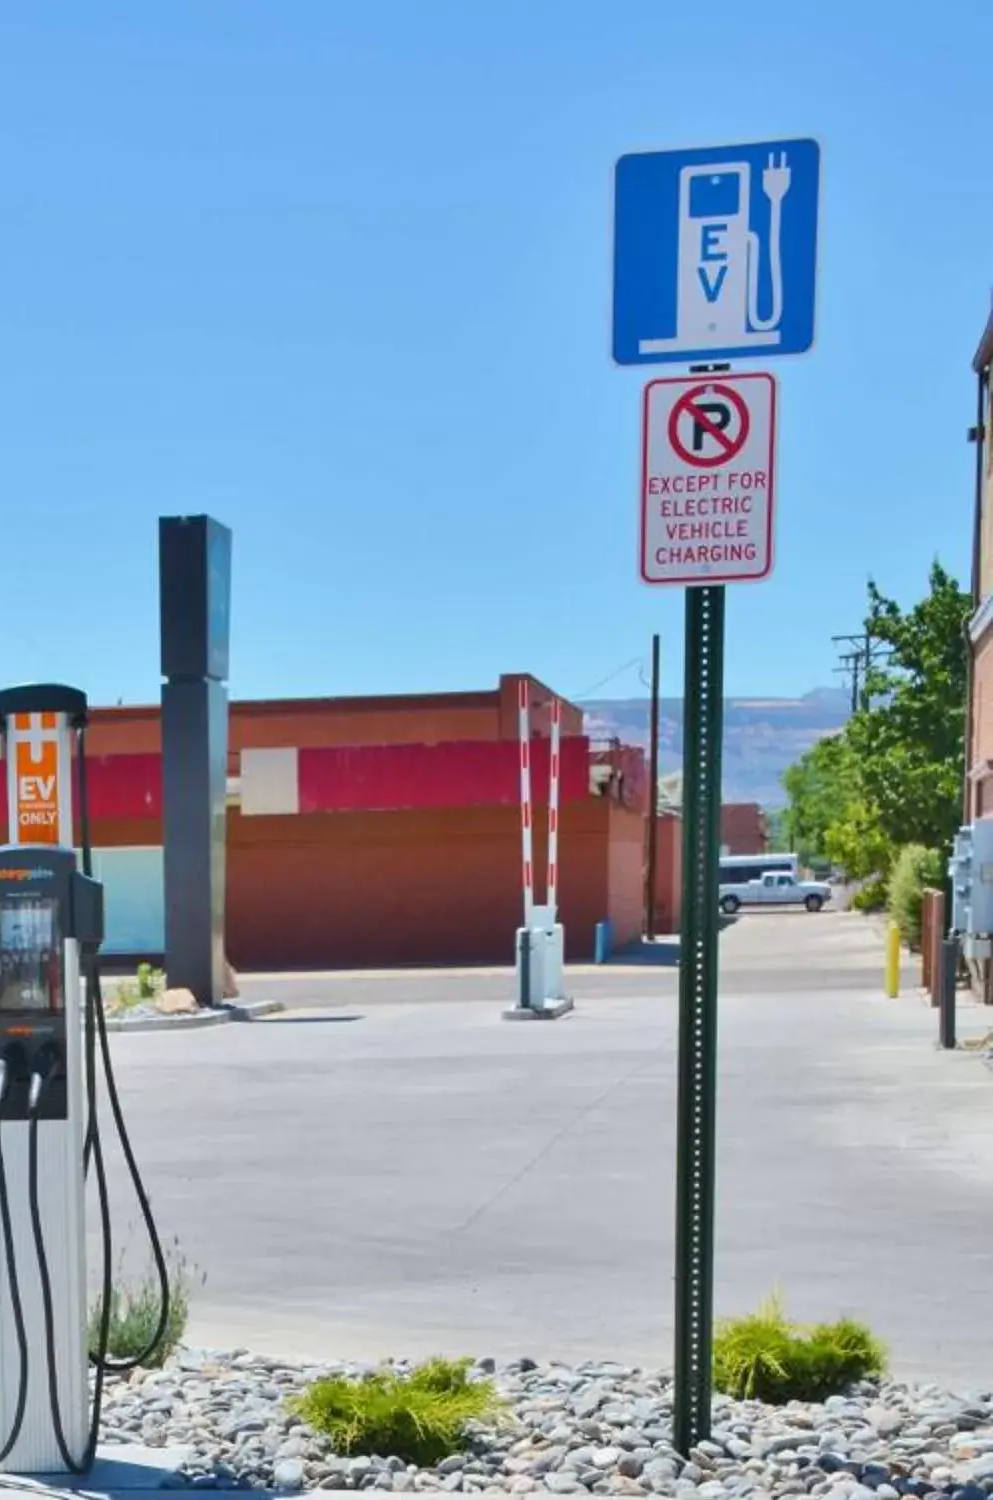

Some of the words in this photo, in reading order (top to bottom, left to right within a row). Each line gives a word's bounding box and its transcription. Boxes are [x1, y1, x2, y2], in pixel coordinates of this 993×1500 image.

[697, 222, 728, 303] EV
[693, 403, 731, 451] P
[648, 474, 718, 495] EXCEPT
[728, 471, 767, 491] FOR
[660, 496, 752, 517] ELECTRIC
[665, 520, 749, 541] VEHICLE
[655, 543, 757, 566] CHARGING
[19, 775, 56, 801] EV
[20, 811, 58, 826] ONLY
